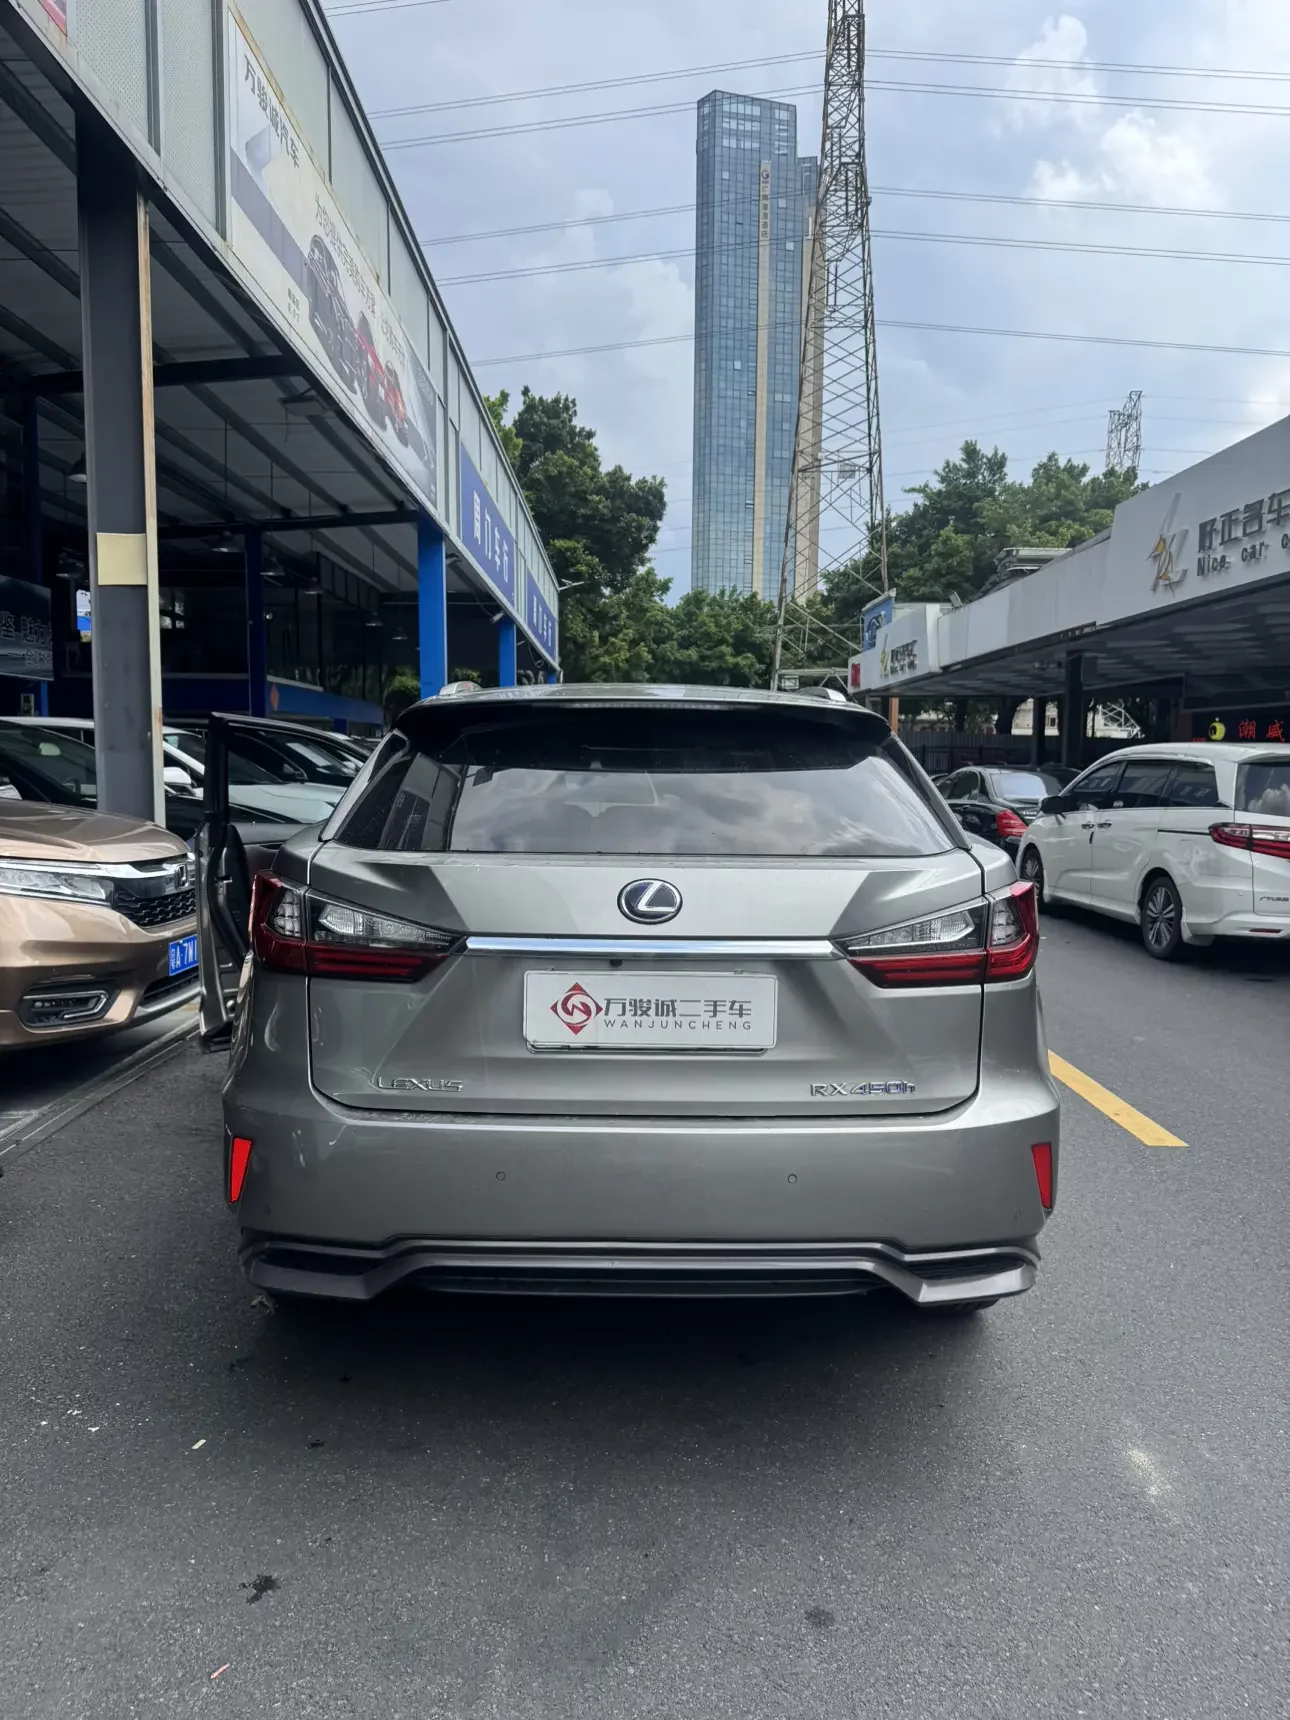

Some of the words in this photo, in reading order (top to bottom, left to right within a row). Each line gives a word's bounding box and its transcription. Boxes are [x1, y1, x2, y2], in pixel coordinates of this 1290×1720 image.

[1197, 554, 1228, 576] Nice
[1241, 541, 1266, 562] car
[603, 997, 752, 1018] 万骏诚二手车
[603, 1019, 752, 1030] WANJUNCHENG
[377, 1077, 463, 1093] LEXUS
